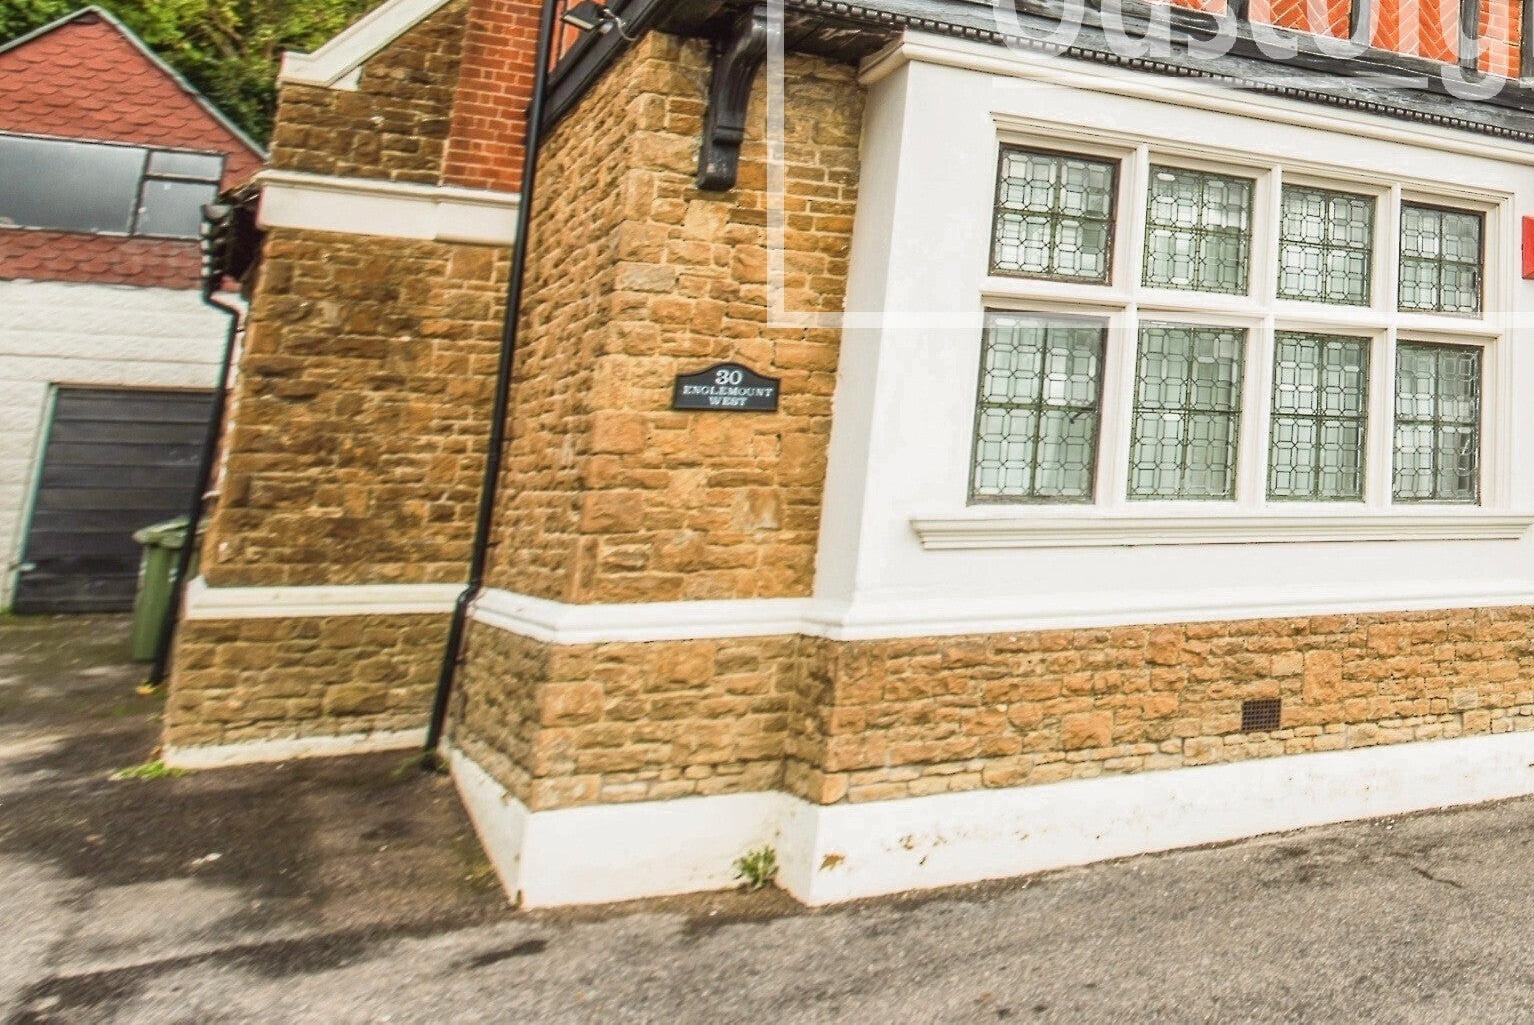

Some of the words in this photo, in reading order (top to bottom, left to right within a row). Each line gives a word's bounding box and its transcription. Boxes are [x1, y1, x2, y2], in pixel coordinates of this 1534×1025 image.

[715, 369, 744, 385] 30
[682, 385, 774, 397] ENGLEMOUNT
[709, 396, 748, 406] WEST
